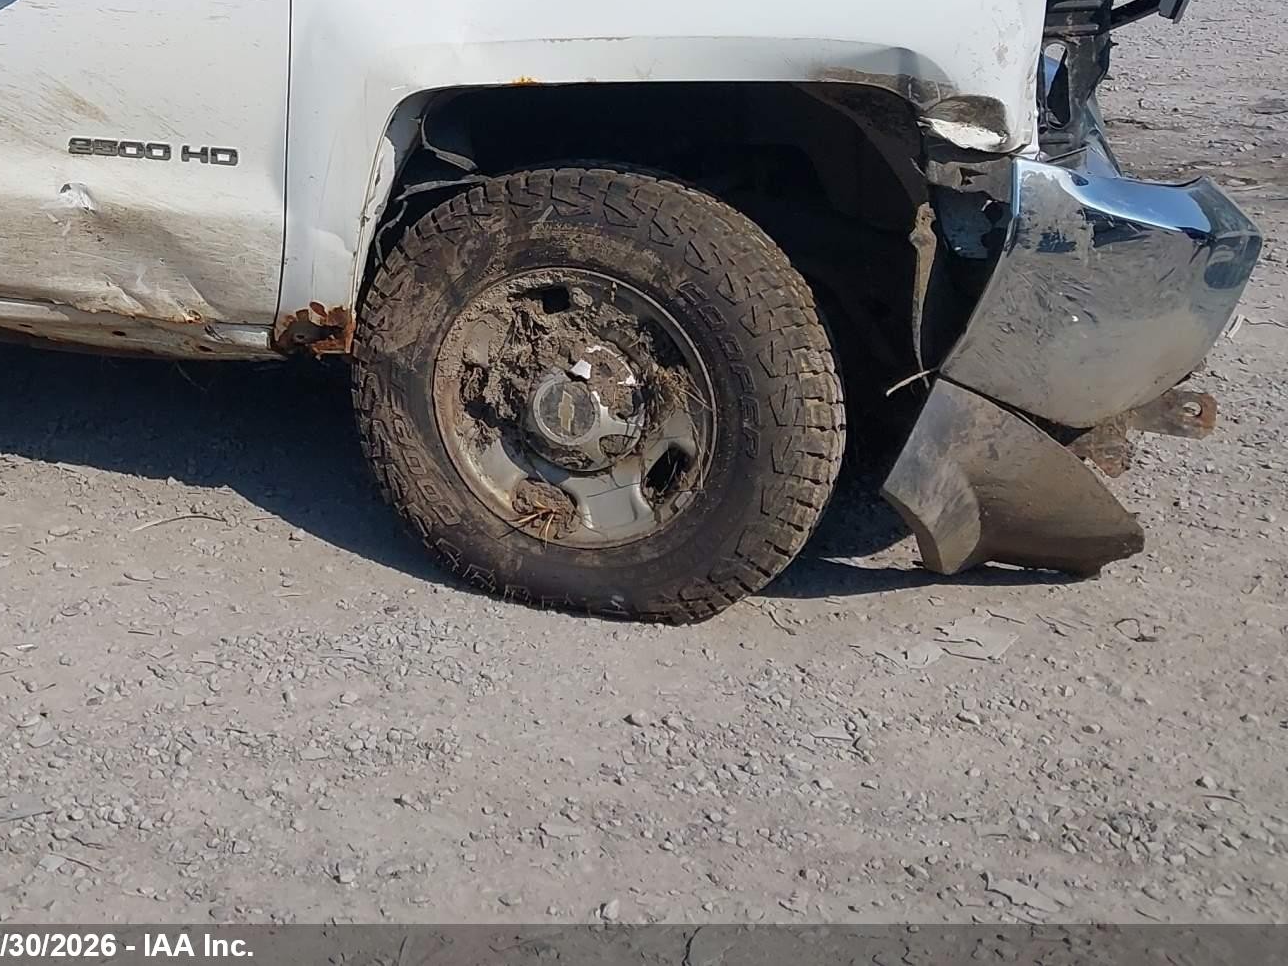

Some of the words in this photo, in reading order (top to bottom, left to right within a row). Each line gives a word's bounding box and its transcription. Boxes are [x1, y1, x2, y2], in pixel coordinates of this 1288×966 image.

[68, 137, 172, 161] 2500
[180, 145, 239, 167] HD
[677, 280, 762, 460] COOPER
